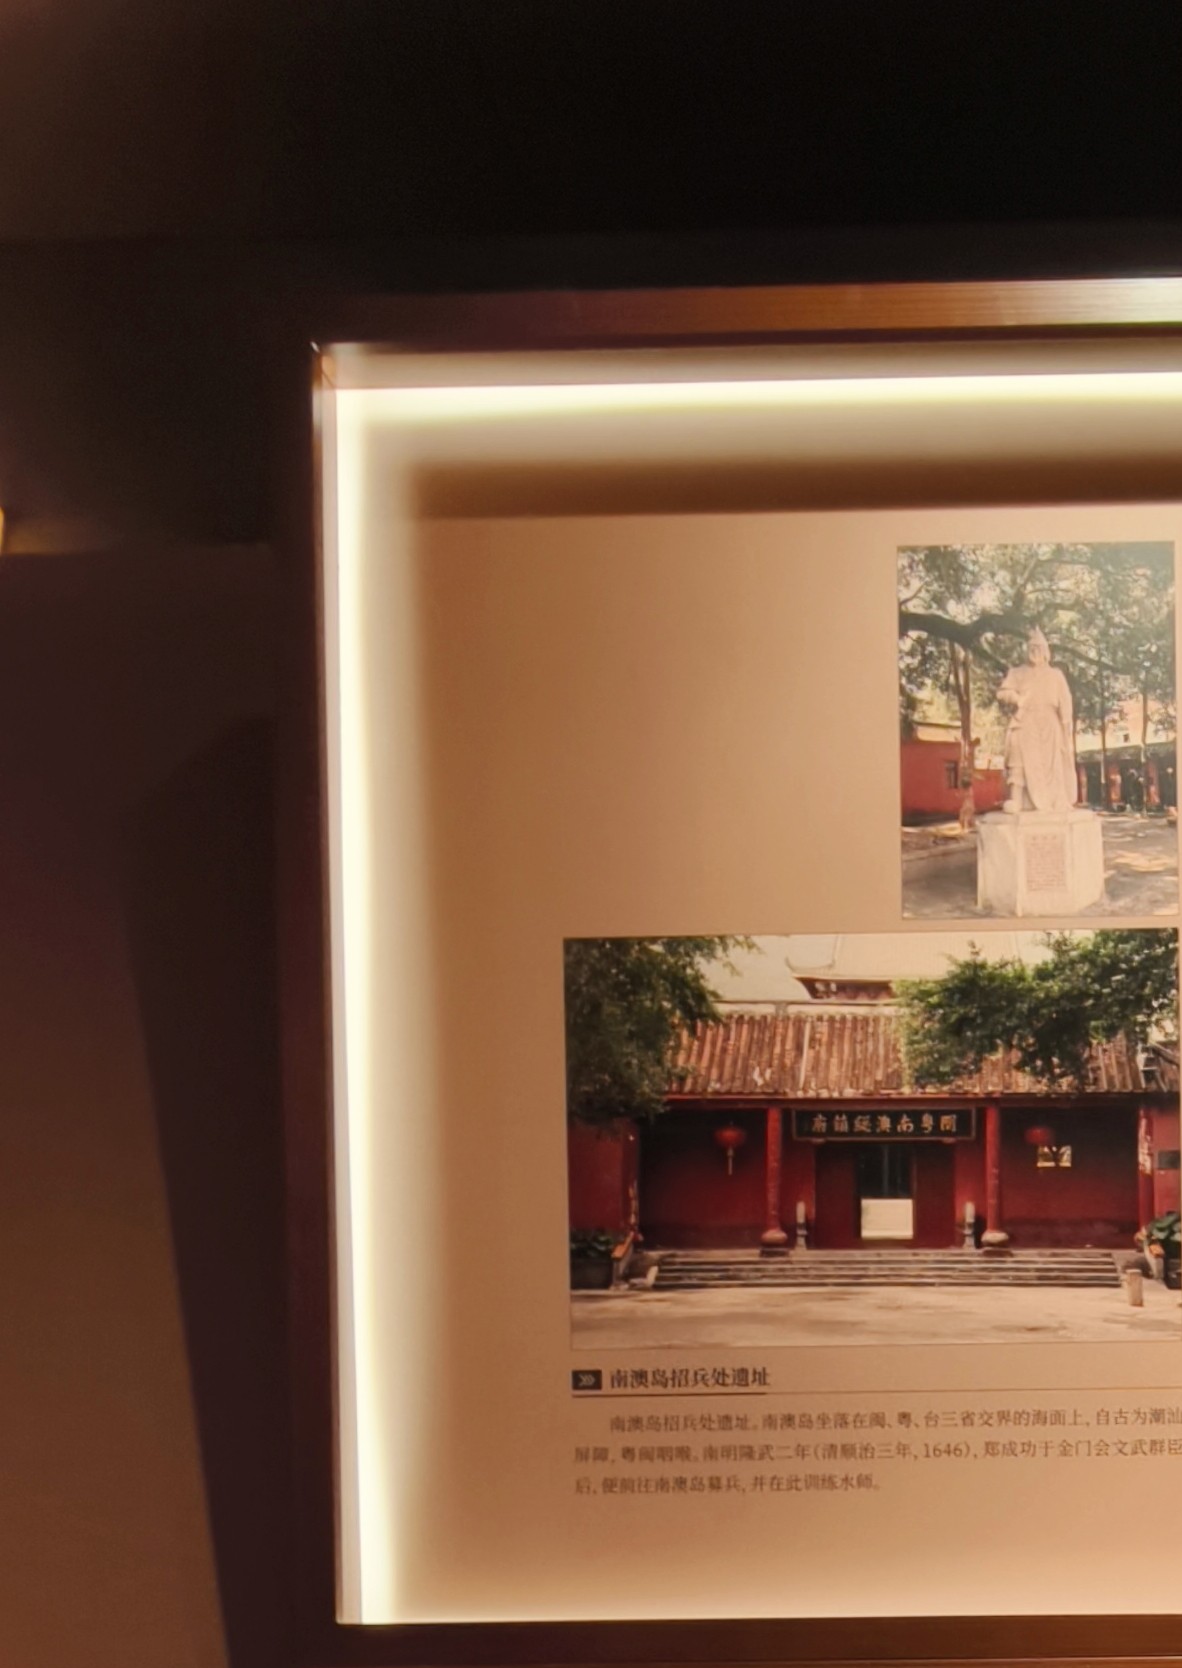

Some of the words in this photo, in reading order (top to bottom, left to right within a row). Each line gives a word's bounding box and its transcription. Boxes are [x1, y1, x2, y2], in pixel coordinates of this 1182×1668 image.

[610, 1367, 770, 1391] 南澳岛招兵处遗址
